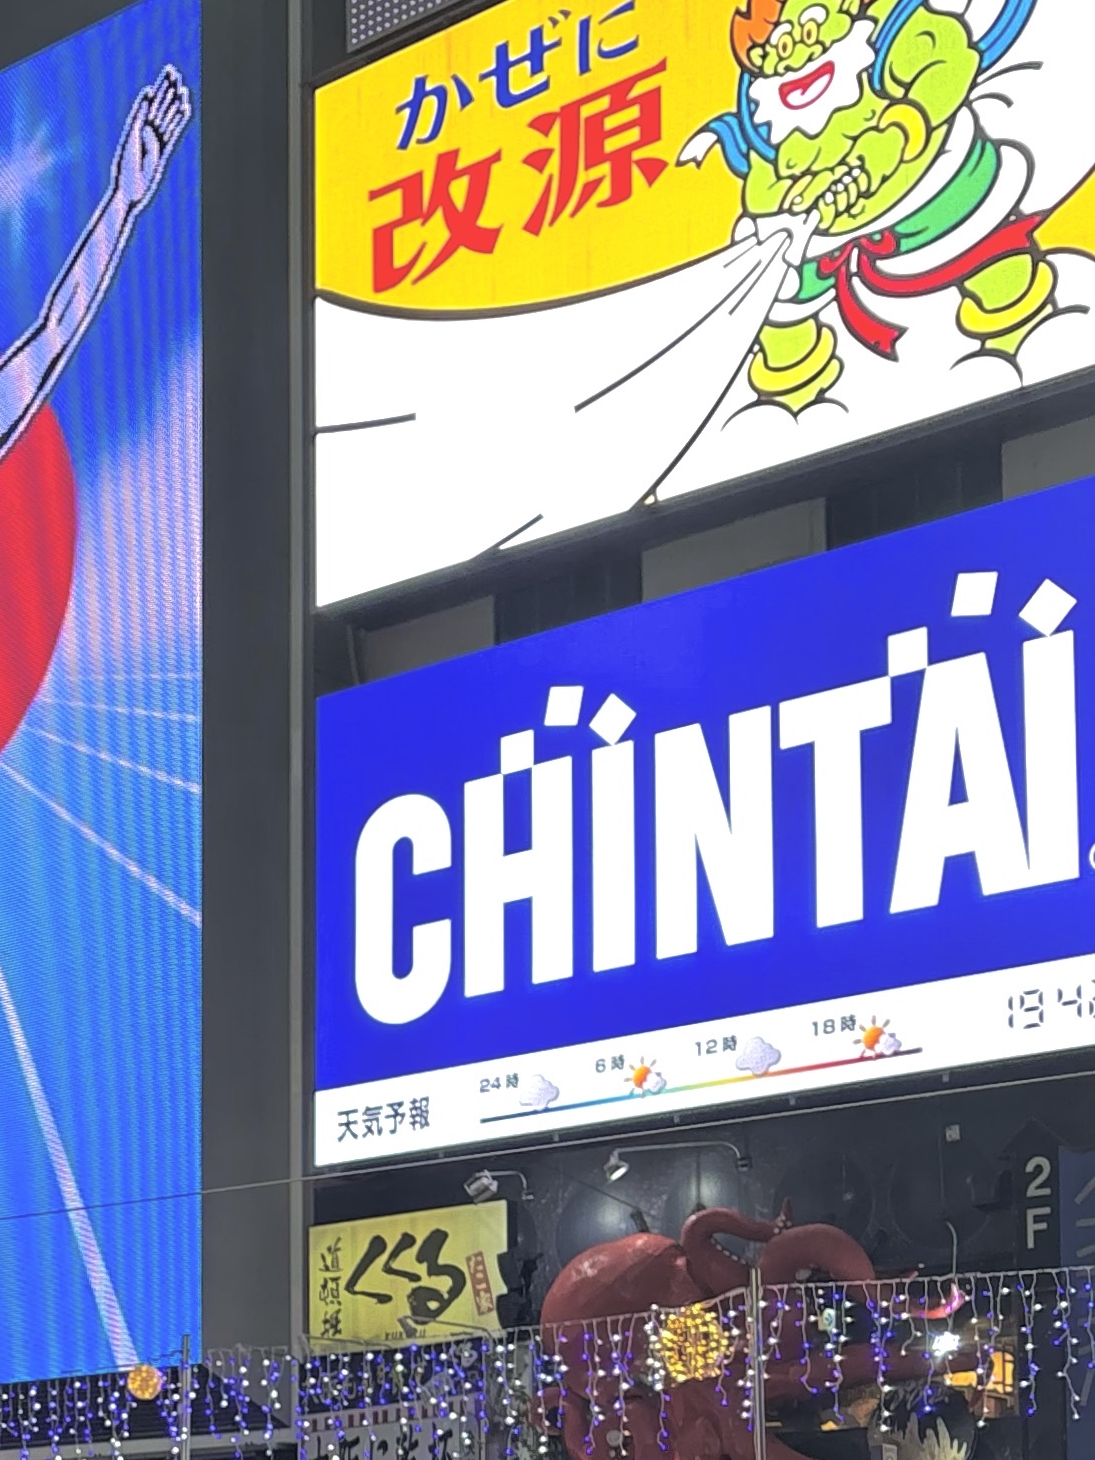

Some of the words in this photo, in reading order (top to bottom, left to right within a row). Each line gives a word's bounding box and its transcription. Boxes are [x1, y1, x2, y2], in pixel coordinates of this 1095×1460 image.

[395, 0, 641, 151] かぜに
[367, 57, 669, 294] 改源
[694, 1035, 738, 1057] 12時
[811, 1014, 856, 1037] 18時
[595, 1054, 626, 1074] 6時
[337, 1096, 431, 1143] 天気予報
[318, 1236, 343, 1338] 道頓堀
[344, 1227, 467, 1326] くくる
